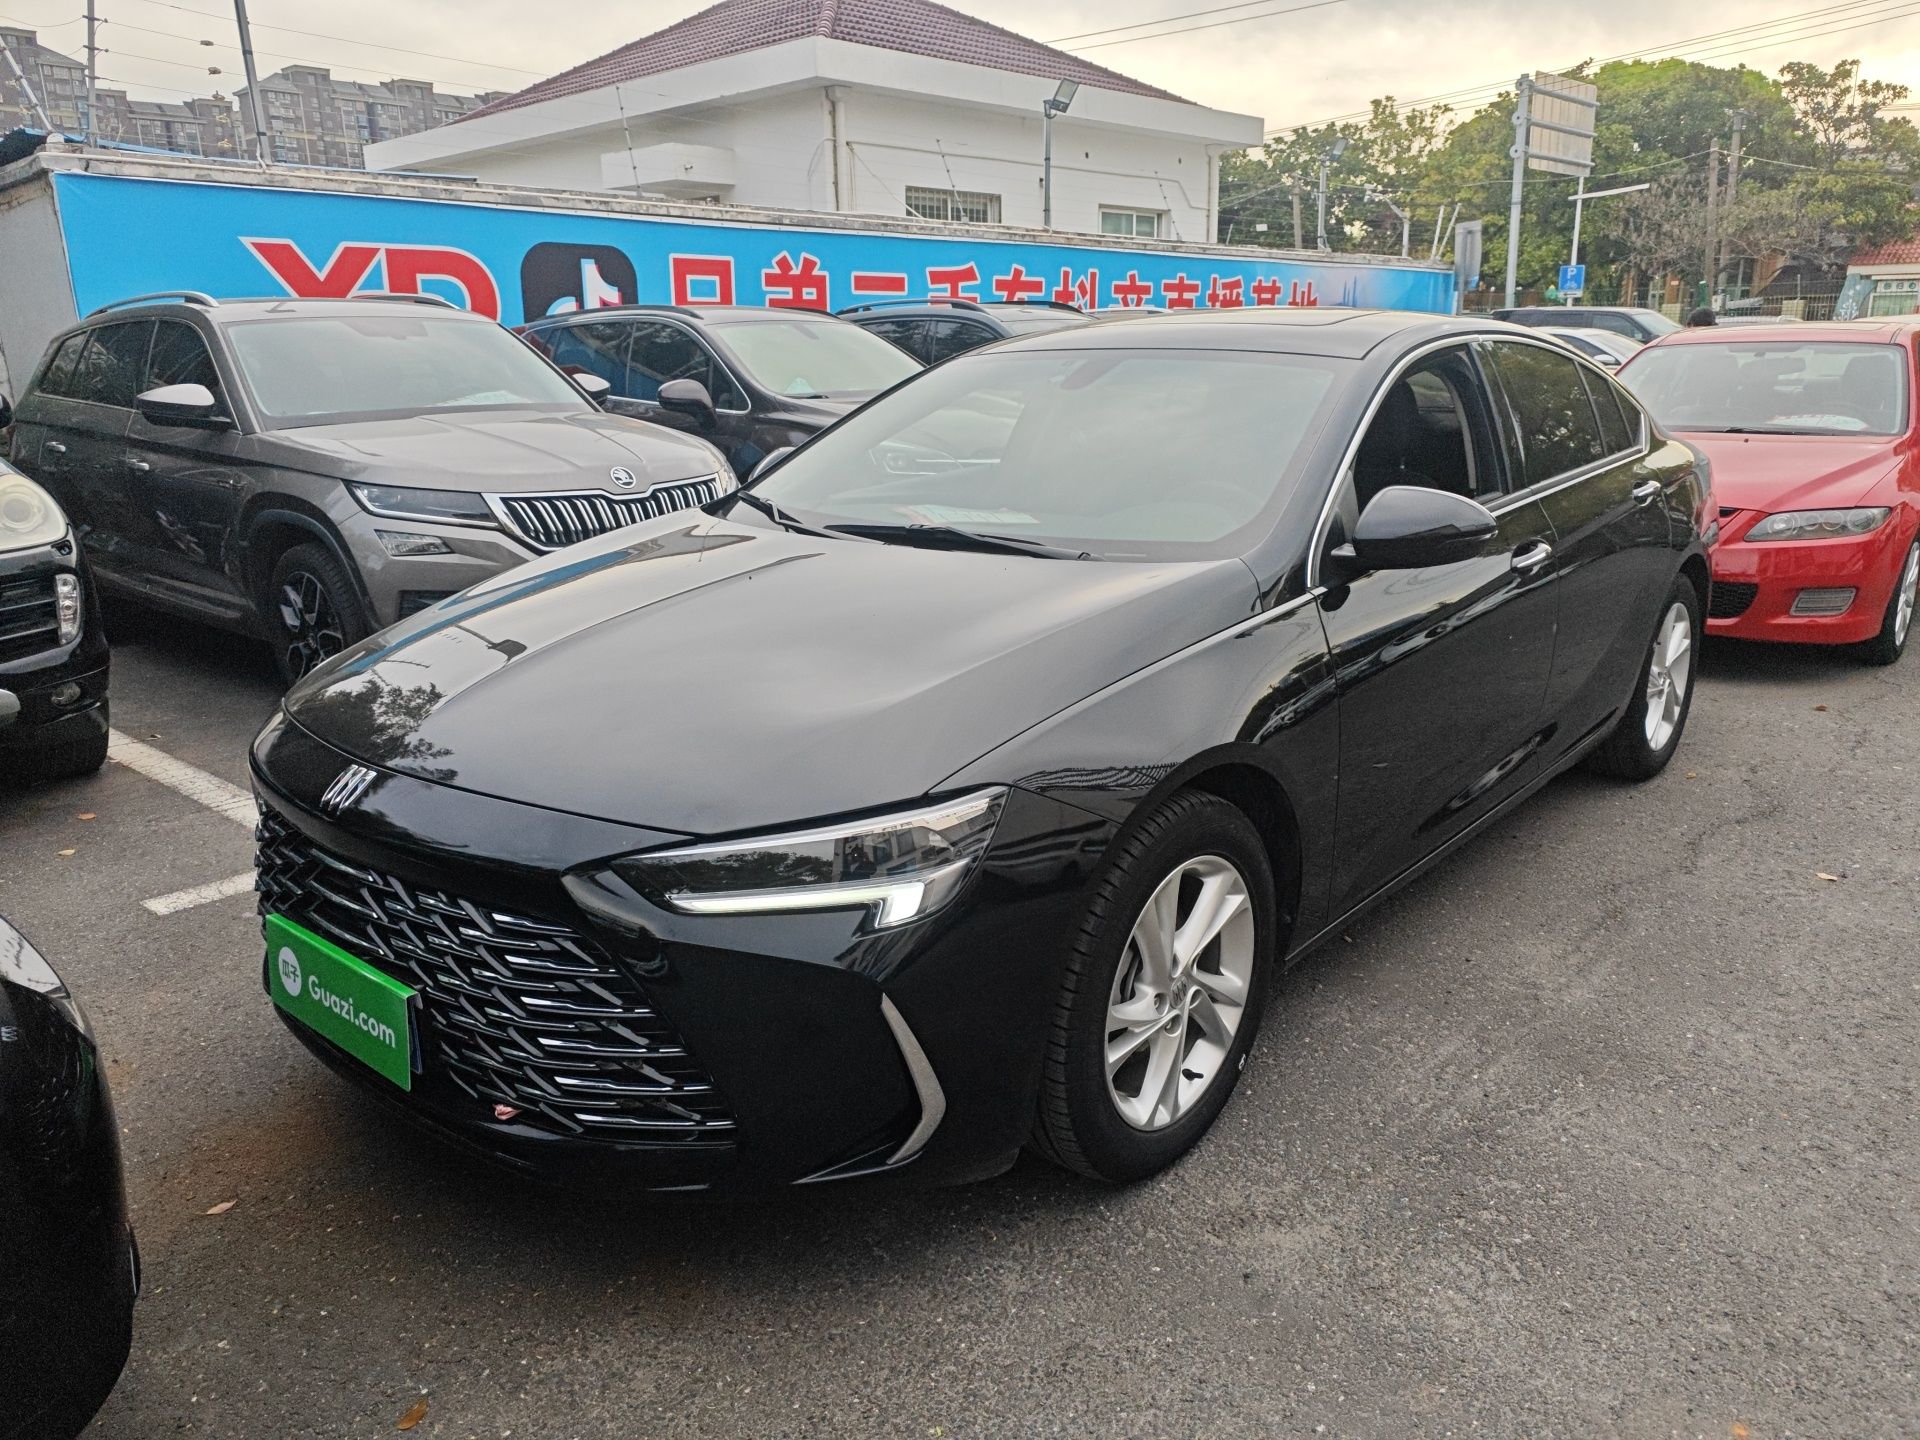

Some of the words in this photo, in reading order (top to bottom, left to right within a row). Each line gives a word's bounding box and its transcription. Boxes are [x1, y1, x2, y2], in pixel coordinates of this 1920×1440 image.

[1567, 267, 1577, 279] P
[282, 958, 299, 983] 瓜子
[308, 974, 396, 1049] Guazi.com
